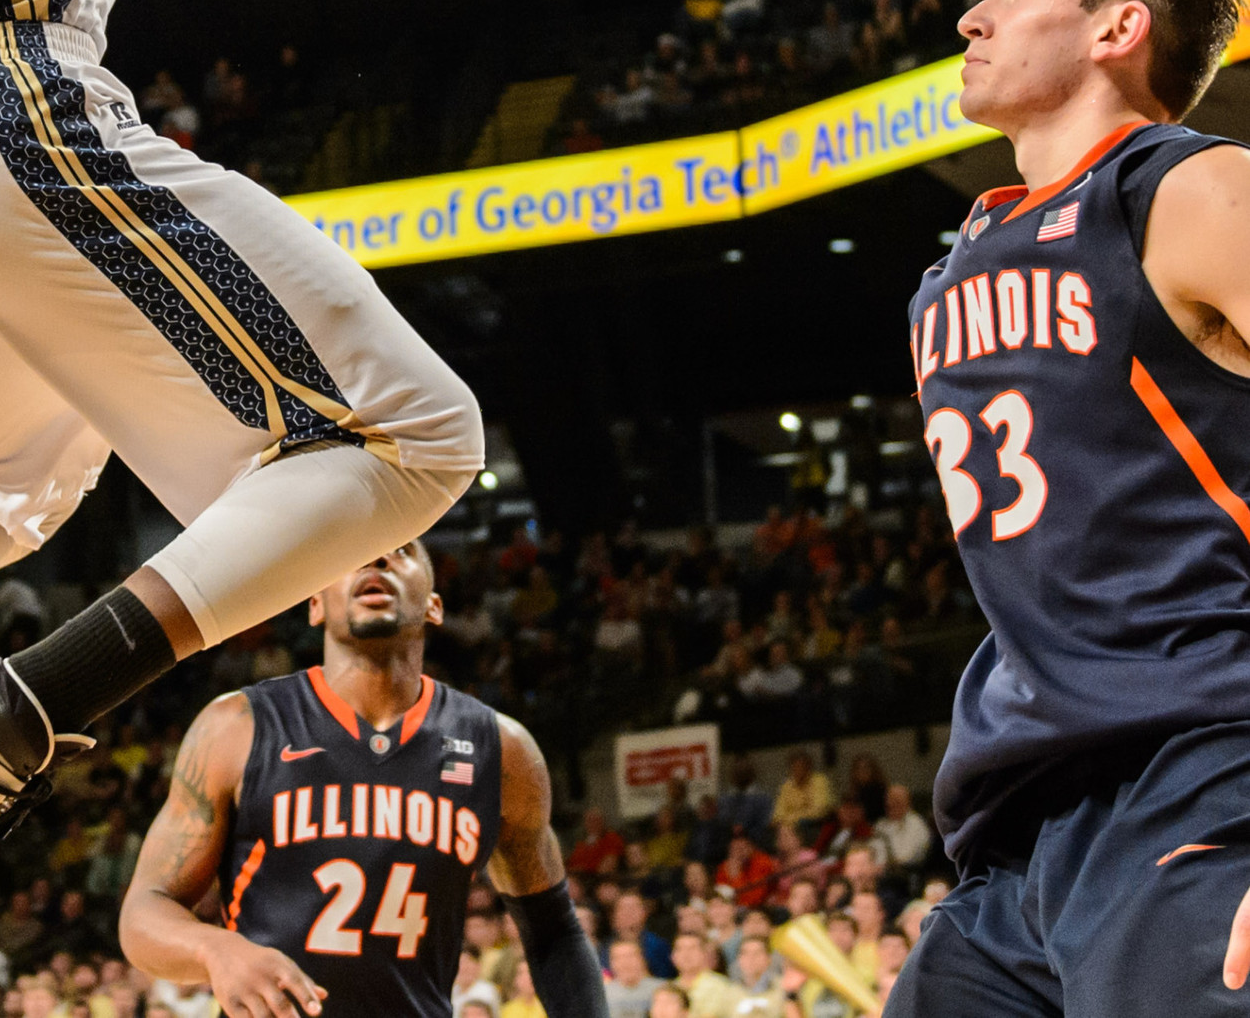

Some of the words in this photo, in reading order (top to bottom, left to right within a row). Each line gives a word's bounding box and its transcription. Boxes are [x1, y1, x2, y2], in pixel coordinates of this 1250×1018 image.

[418, 188, 463, 240] of
[476, 166, 662, 234] Georgia
[924, 389, 1049, 542] 33
[272, 783, 481, 866] ILLINOIS
[305, 858, 429, 959] 24
